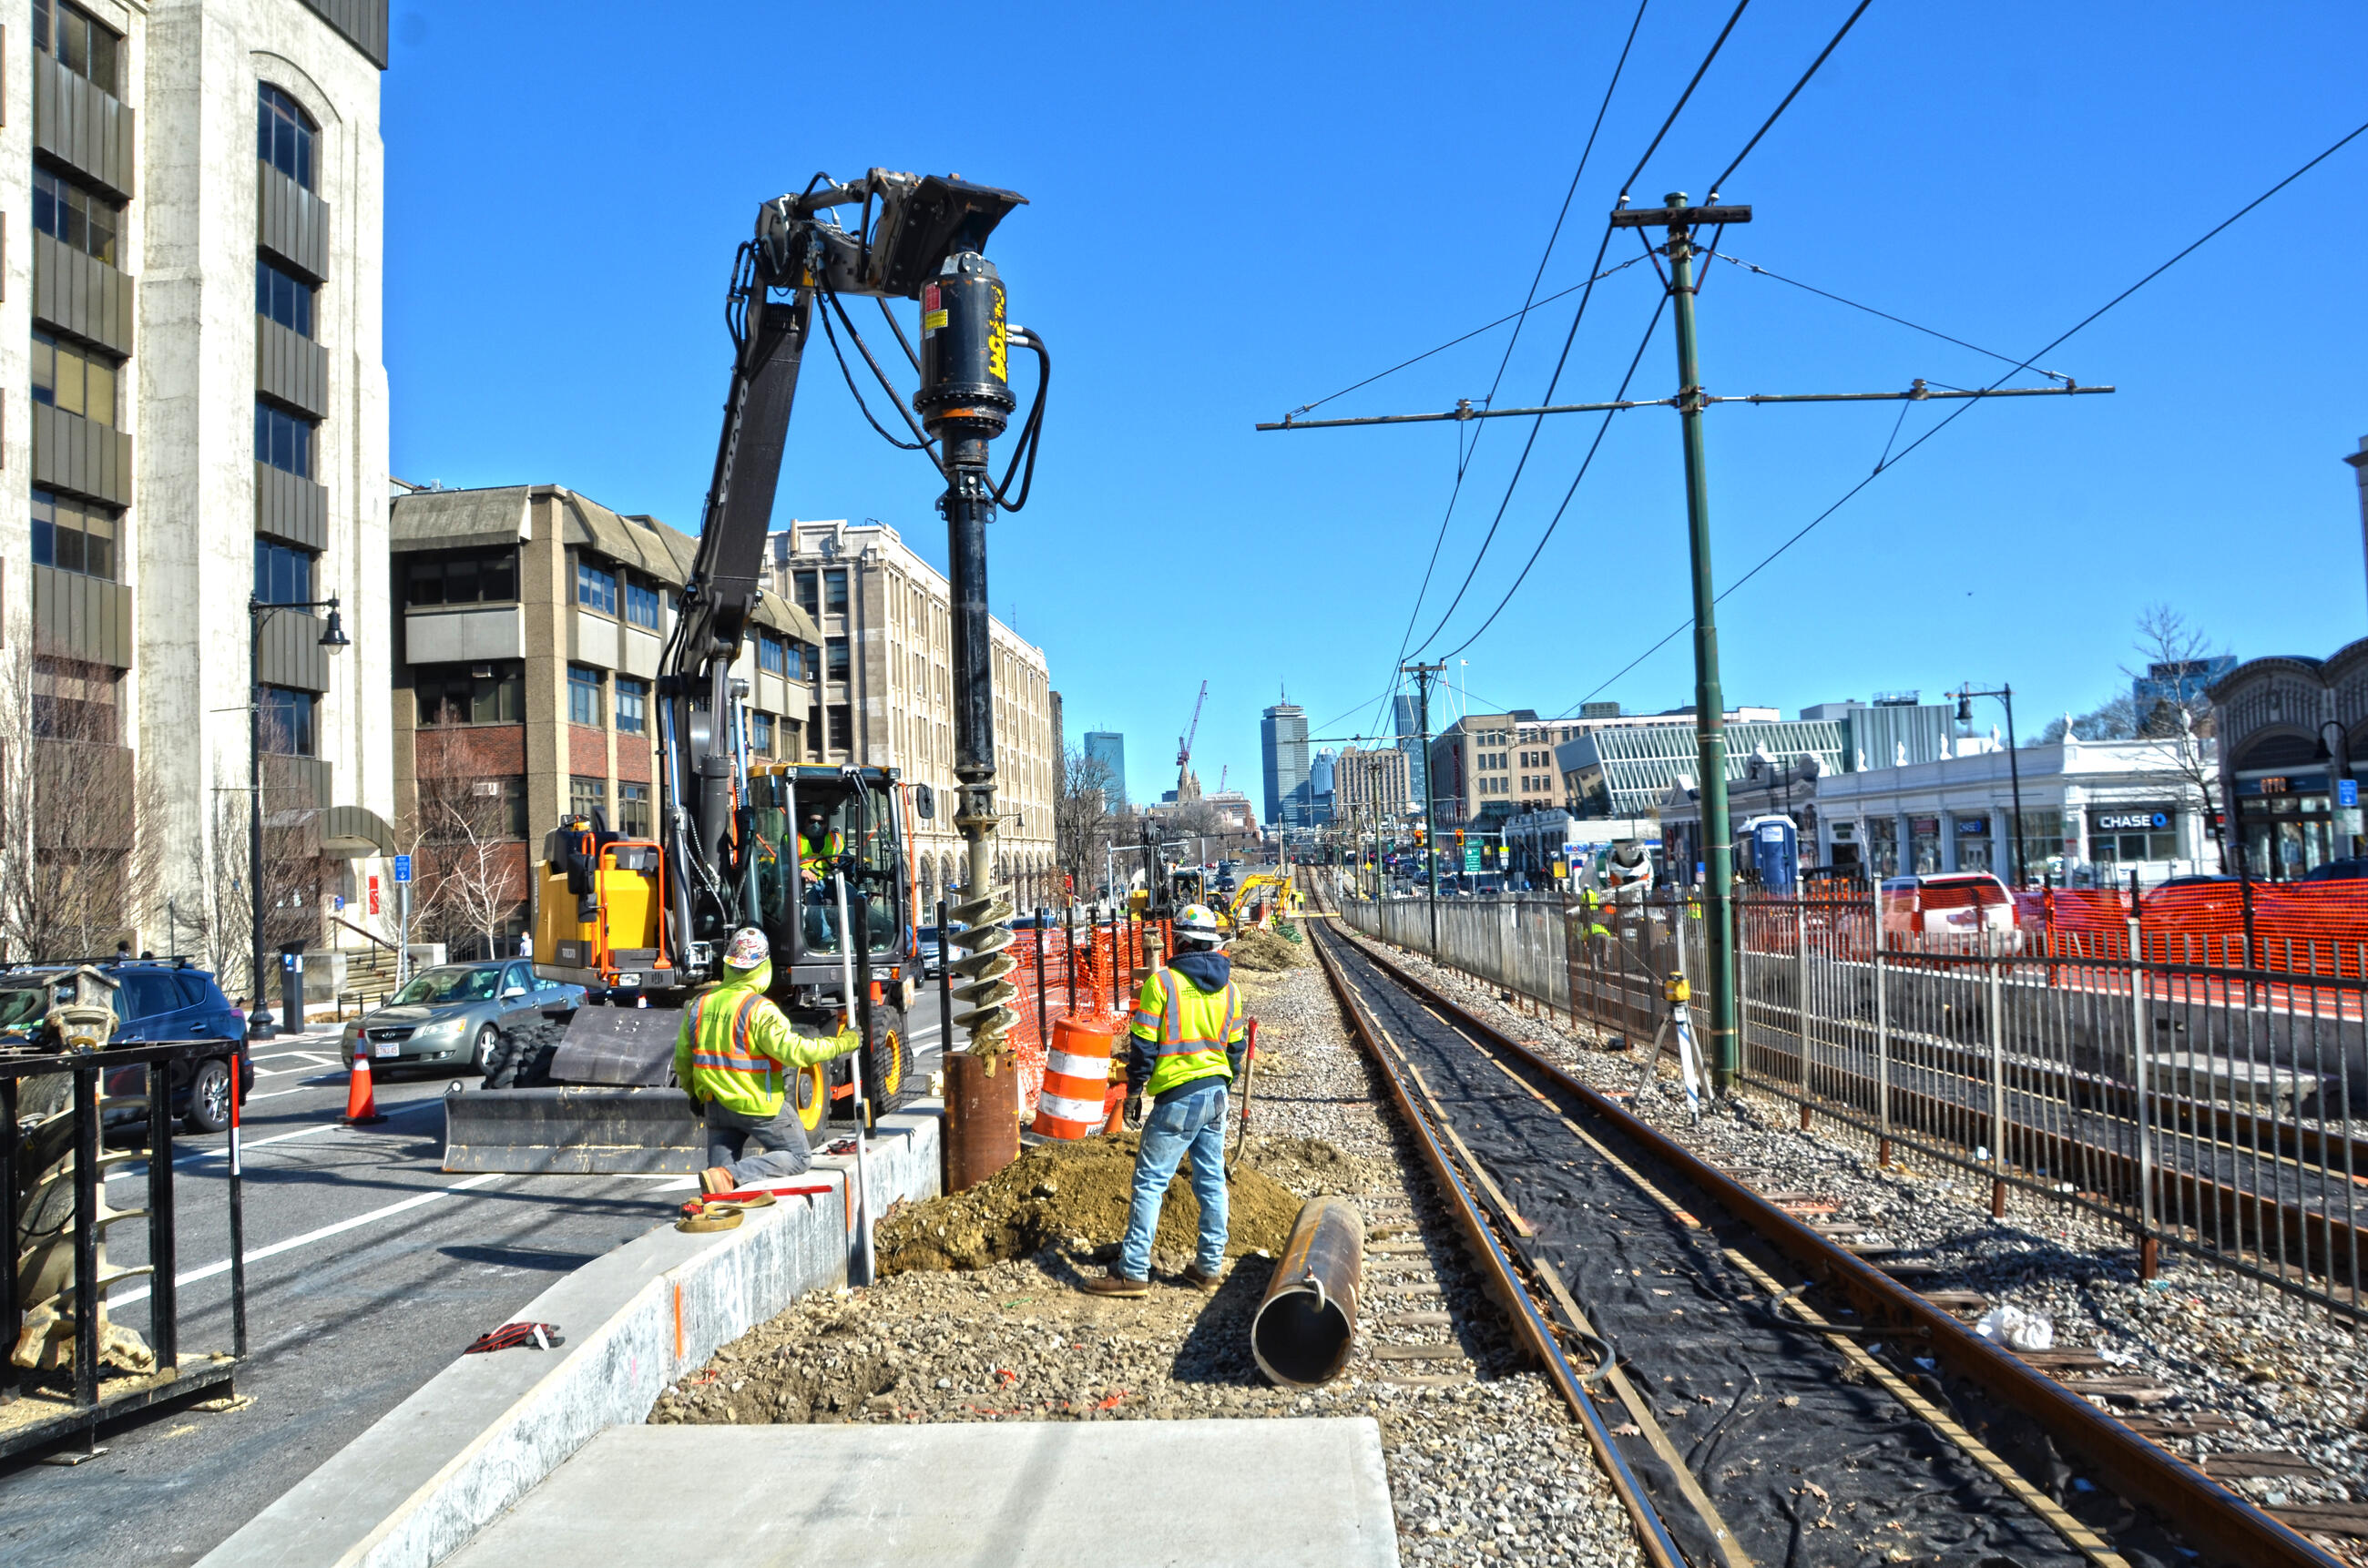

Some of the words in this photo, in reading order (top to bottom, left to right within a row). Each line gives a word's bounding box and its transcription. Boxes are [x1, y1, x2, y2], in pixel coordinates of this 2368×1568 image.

[718, 378, 749, 506] VOLVO
[2099, 814, 2152, 829] CHASE
[1565, 844, 1588, 853] Mobil
